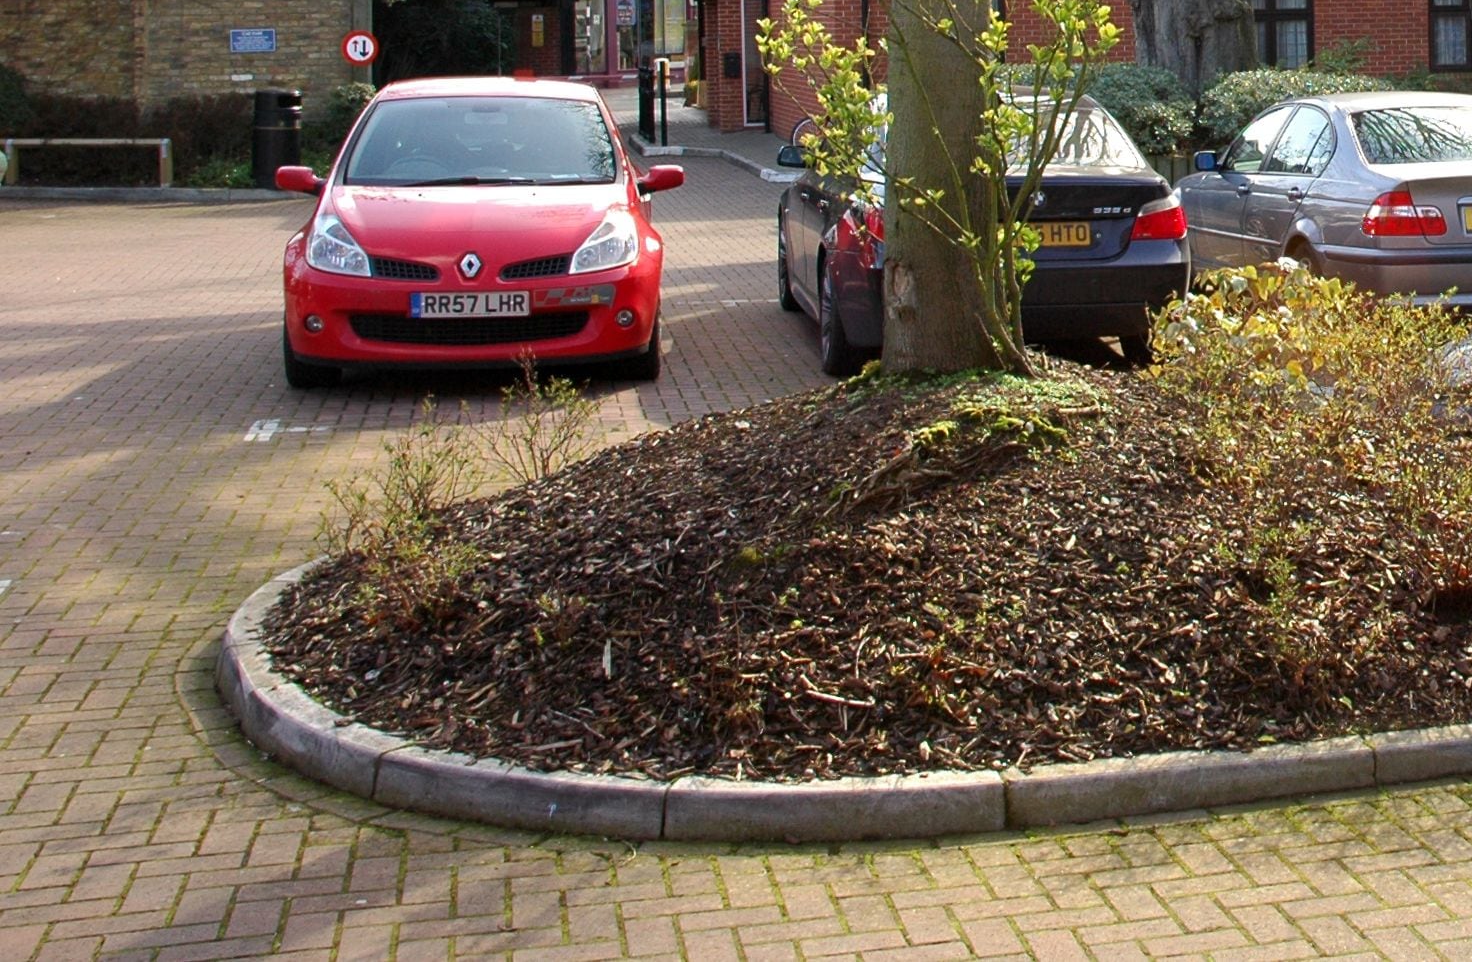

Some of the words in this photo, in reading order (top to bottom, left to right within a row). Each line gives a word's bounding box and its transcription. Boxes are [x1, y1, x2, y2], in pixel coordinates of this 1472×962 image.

[1050, 224, 1087, 242] HTO
[424, 295, 479, 313] RR57
[485, 294, 525, 312] LHR
